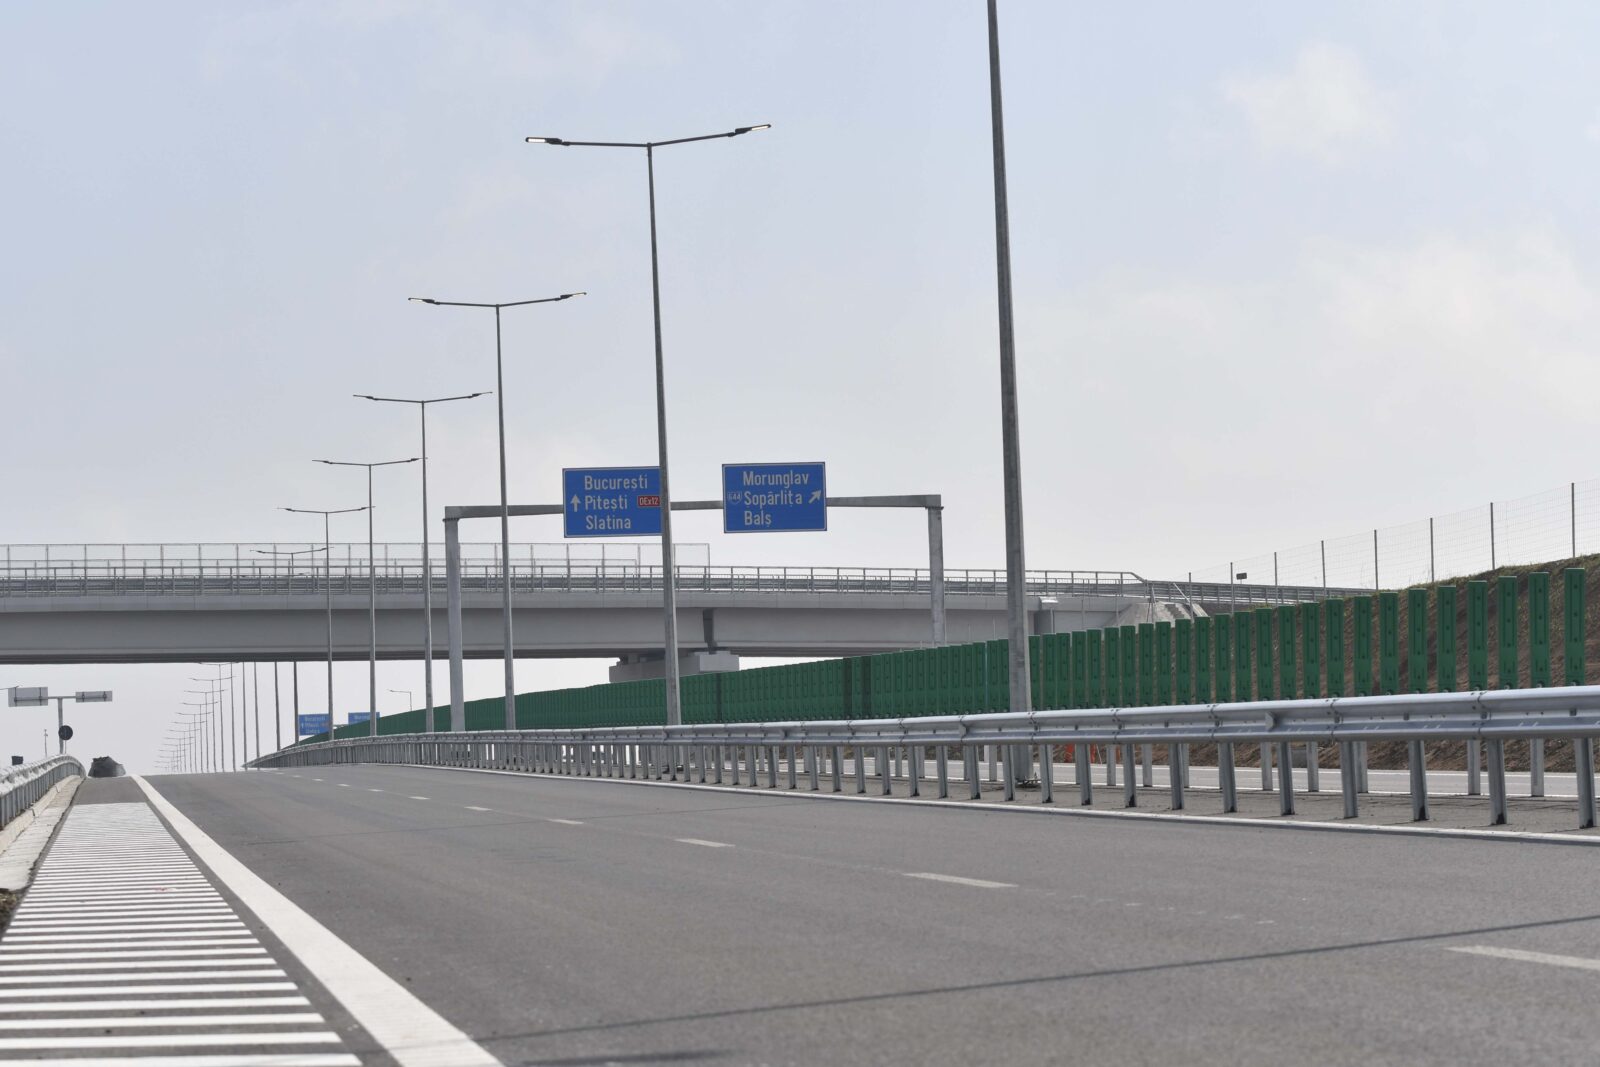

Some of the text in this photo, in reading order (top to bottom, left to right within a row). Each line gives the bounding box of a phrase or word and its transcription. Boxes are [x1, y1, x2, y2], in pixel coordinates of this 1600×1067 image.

[742, 470, 809, 489] Morunglav
[584, 494, 628, 512] Pitești
[585, 514, 631, 530] Slatina
[744, 509, 772, 527] Balș
